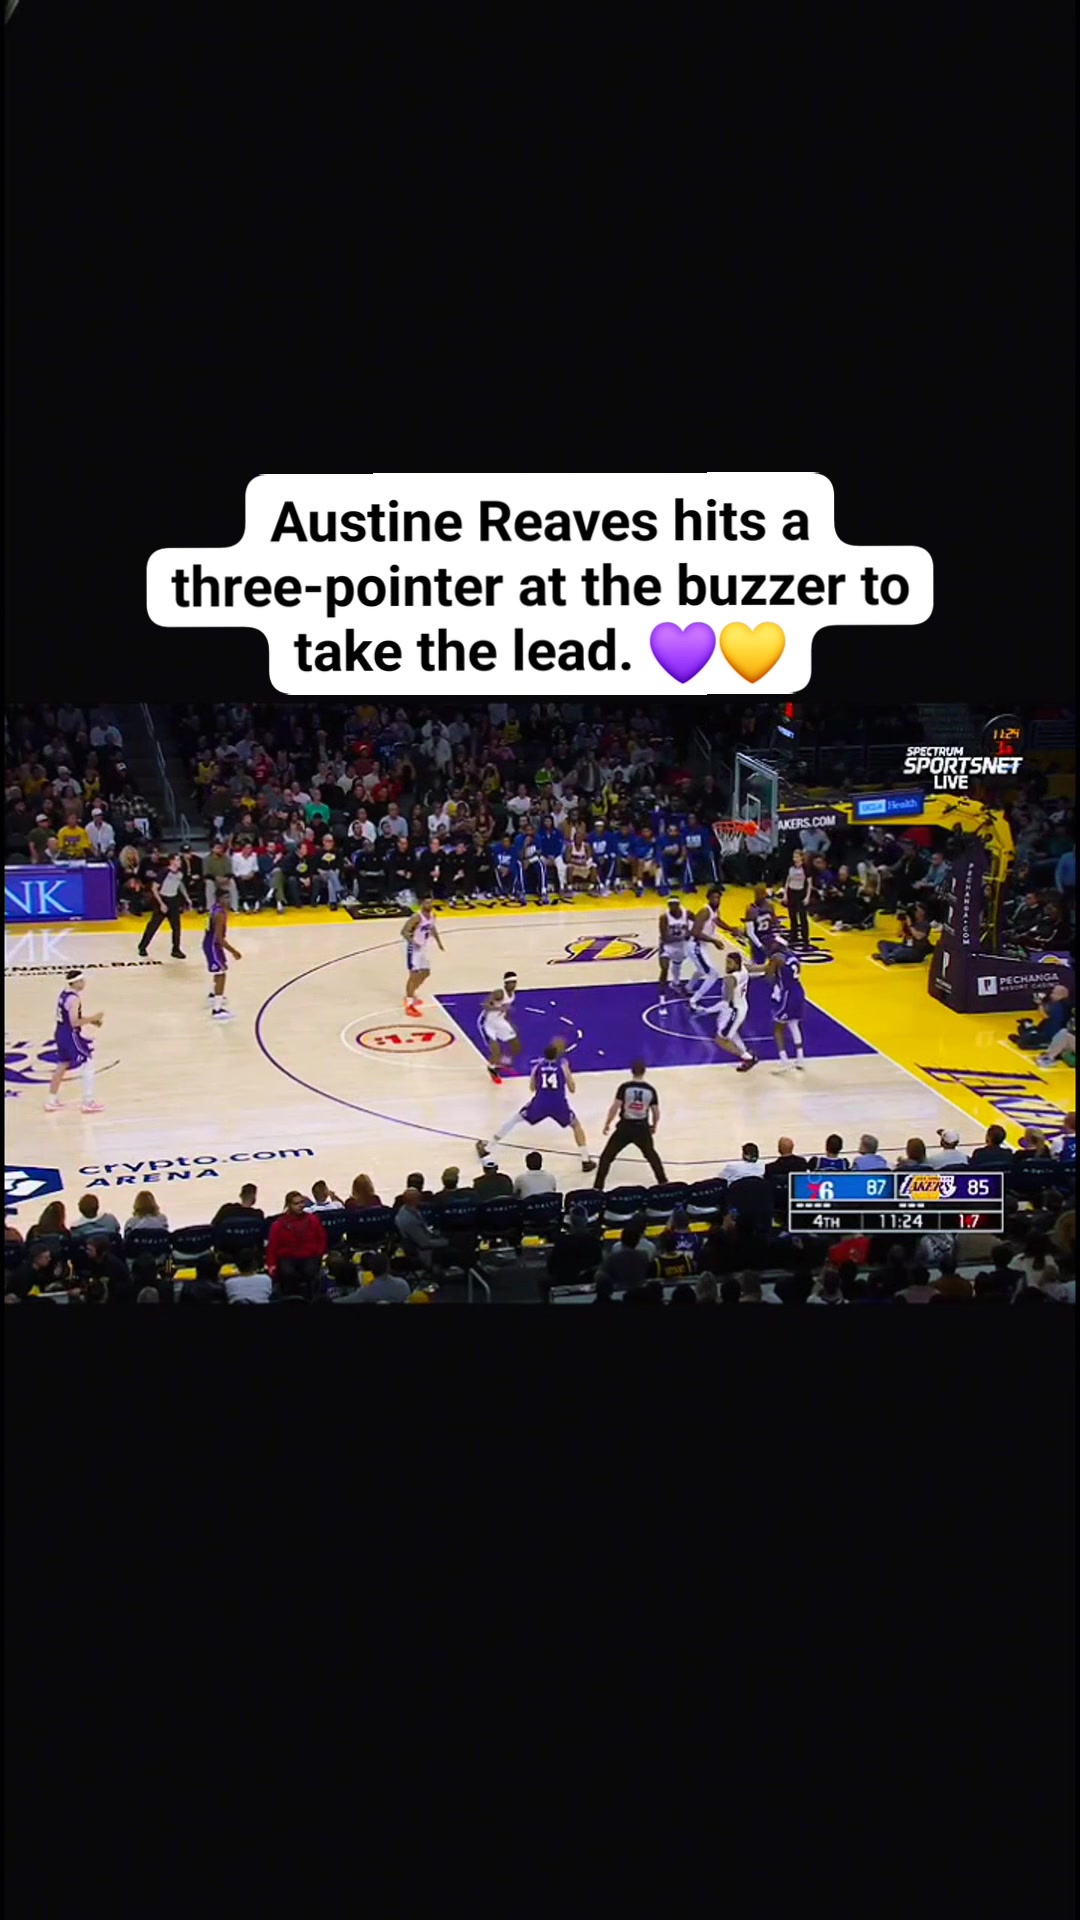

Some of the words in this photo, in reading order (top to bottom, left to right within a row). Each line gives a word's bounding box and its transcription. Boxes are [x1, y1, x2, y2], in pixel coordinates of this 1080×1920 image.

[1000, 973, 1059, 986] PECHANGA
[541, 1073, 558, 1089] 14
[79, 1147, 315, 1176] crypto.com
[86, 1168, 220, 1189] ARENA
